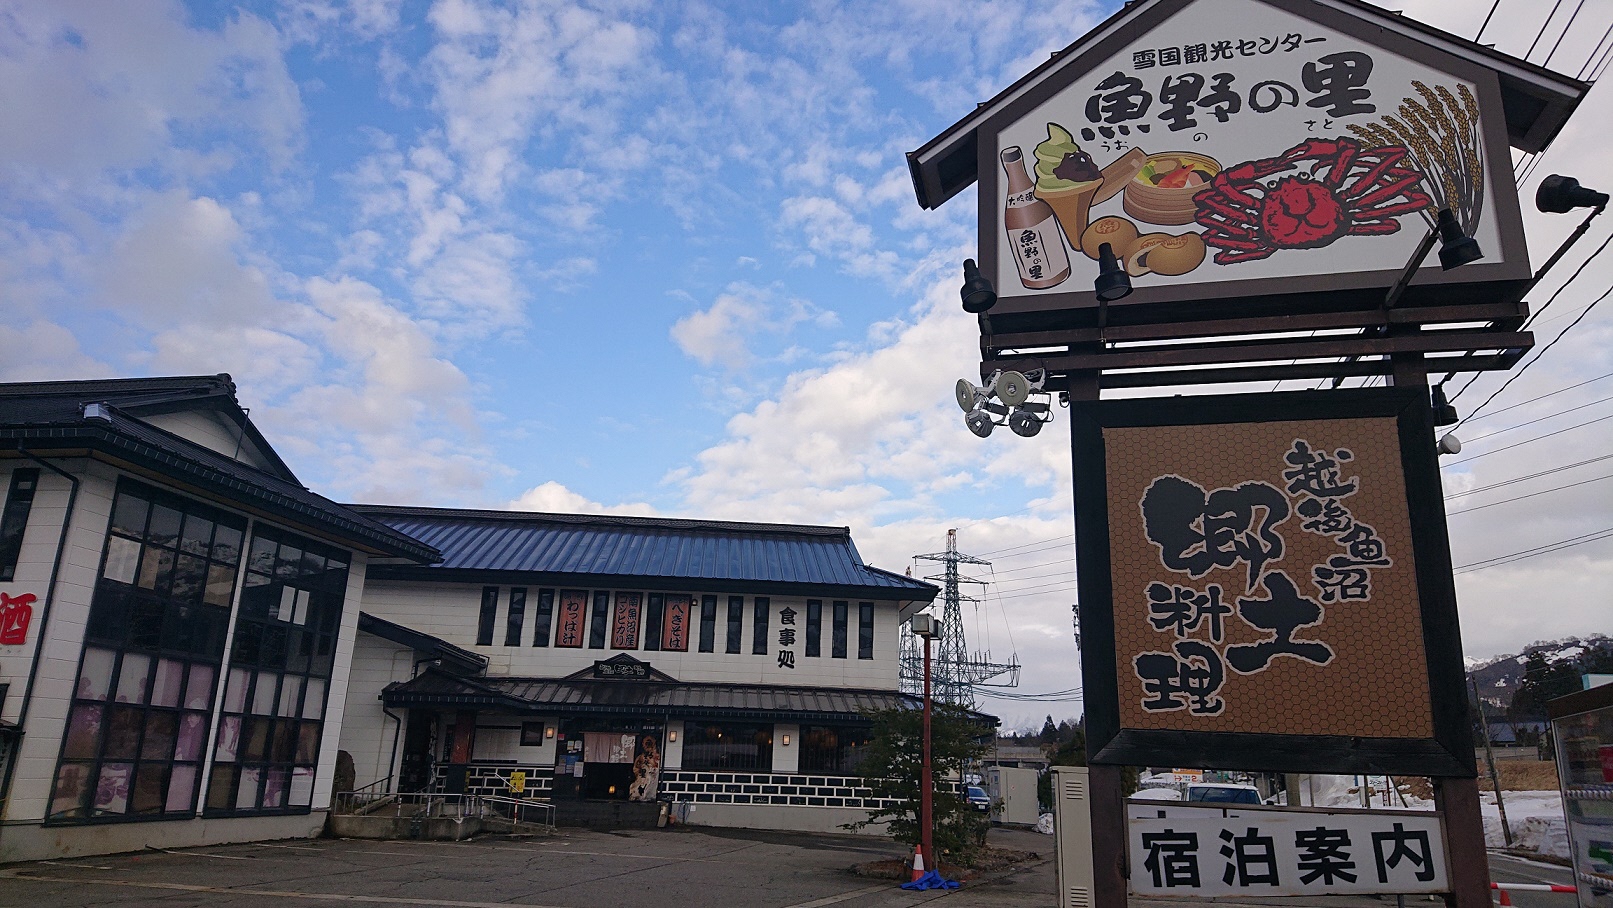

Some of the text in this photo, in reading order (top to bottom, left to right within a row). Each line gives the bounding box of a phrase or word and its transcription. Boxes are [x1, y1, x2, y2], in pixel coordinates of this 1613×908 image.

[1133, 33, 1328, 71] 雪国観光センター
[1080, 46, 1377, 142] 魚野の里
[1101, 139, 1130, 153] うお
[1192, 132, 1209, 143] の
[1304, 119, 1334, 132] さと
[1020, 229, 1043, 280] 魚野の里
[1282, 438, 1393, 605] 越後魚沼
[777, 607, 797, 669] 食事処
[1142, 822, 1436, 888] 宿泊案内
